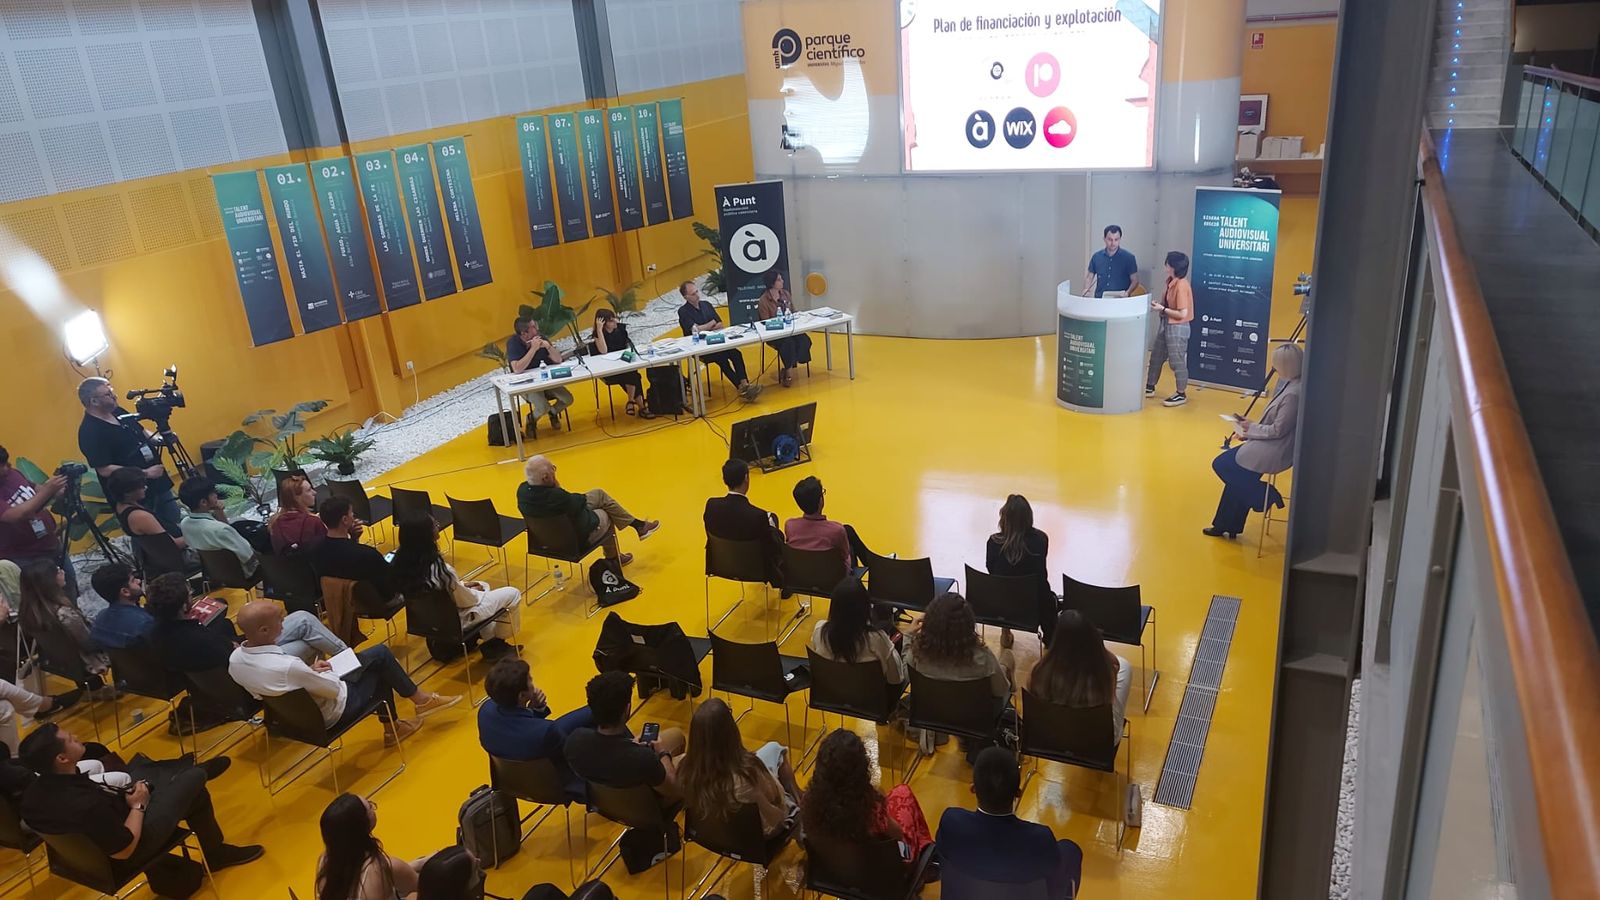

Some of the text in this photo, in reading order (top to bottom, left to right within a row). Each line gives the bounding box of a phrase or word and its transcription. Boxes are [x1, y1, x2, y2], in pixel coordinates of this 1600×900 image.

[934, 7, 1121, 33] Plan de financiación y explotación
[805, 34, 850, 49] parque
[806, 45, 865, 60] científico
[584, 115, 600, 124] 08.
[612, 112, 626, 121] 09.
[638, 109, 652, 118] 10.
[523, 122, 540, 132] 06.
[555, 118, 571, 128] 07.
[442, 145, 461, 156] 05.
[404, 152, 424, 164] 04.
[366, 159, 387, 171] 03.
[322, 166, 345, 178] 02.
[277, 172, 302, 185] 01.
[723, 196, 756, 207] À Punt
[1220, 216, 1248, 228] TALENT
[1219, 228, 1270, 241] AUDIOVISUAL
[743, 230, 767, 262] à
[1219, 239, 1270, 253] UNIVERSITARI
